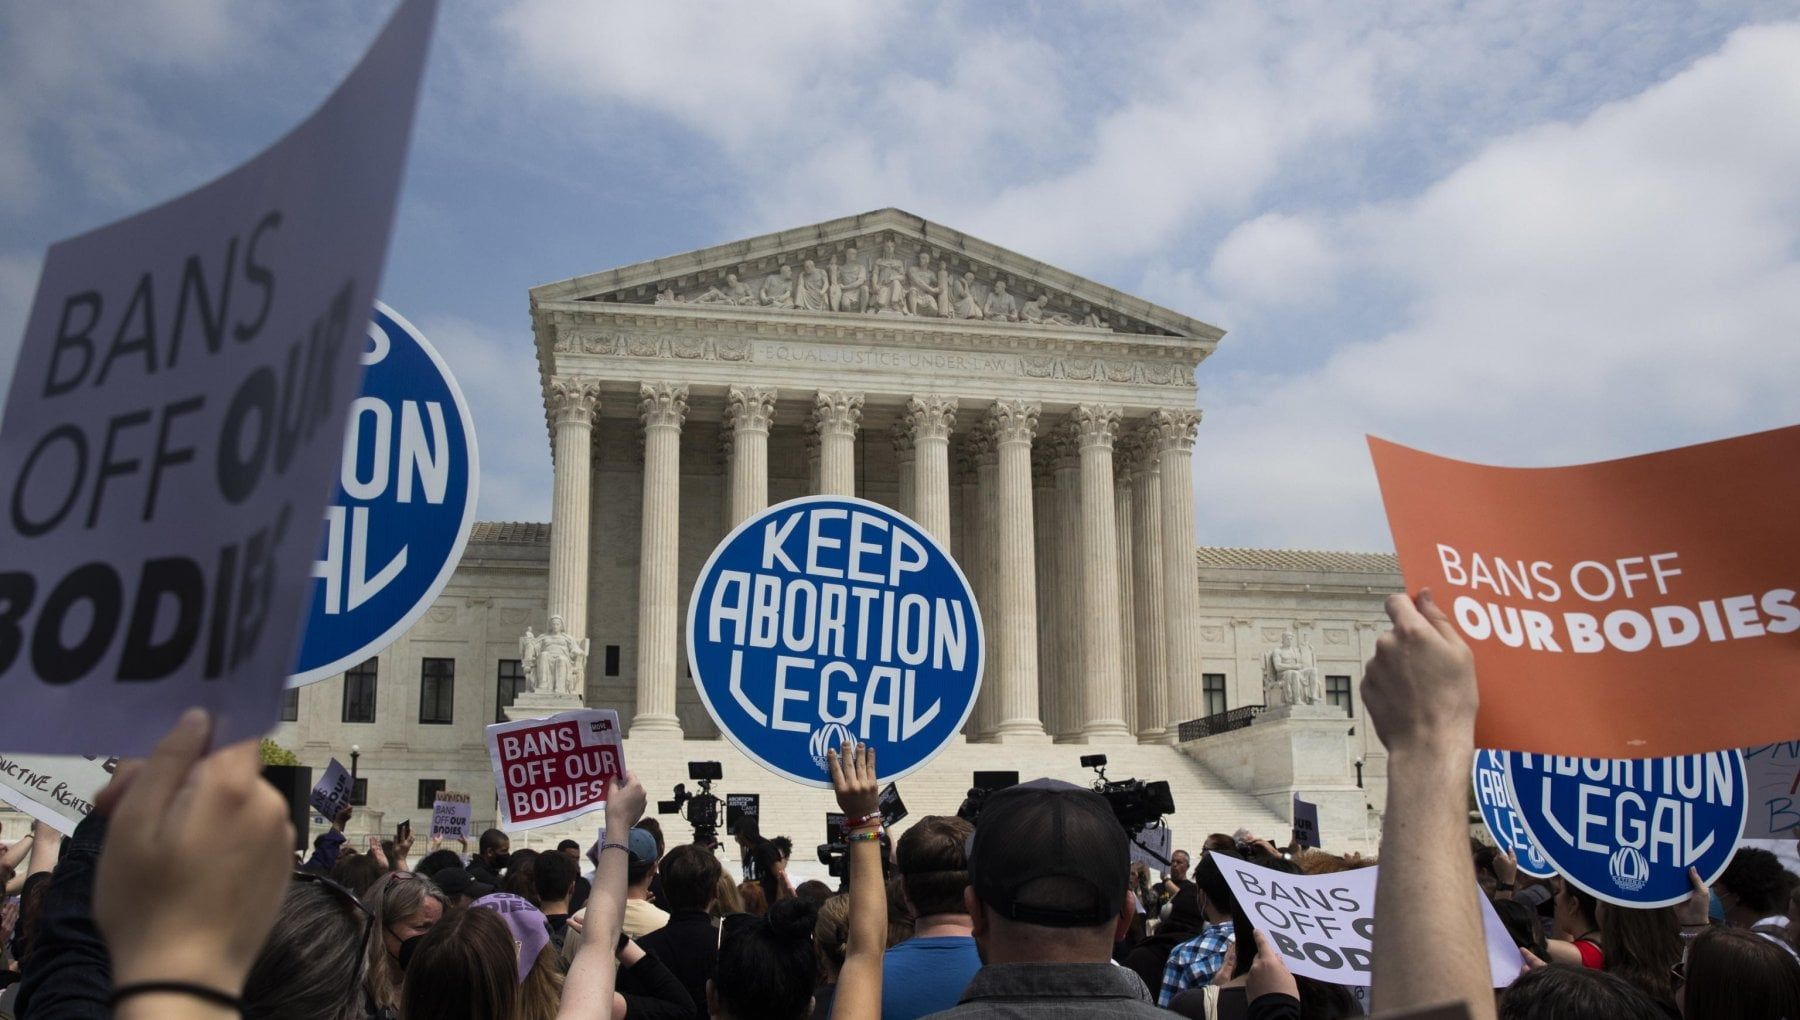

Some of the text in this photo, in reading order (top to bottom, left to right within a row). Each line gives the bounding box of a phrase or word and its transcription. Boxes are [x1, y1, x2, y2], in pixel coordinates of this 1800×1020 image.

[43, 210, 284, 398] BANS
[766, 346, 1007, 371] EQUAL JUSTICE UNDER LAW
[10, 395, 206, 539] OFF
[762, 509, 929, 586] KEEP
[1436, 543, 1682, 602] BANS OFF
[708, 569, 967, 672] ABORTION
[1453, 588, 1800, 653] OUR BODIES
[729, 650, 941, 743] LEGAL
[503, 727, 576, 760] BANS
[508, 750, 618, 788] OFF OUR
[436, 804, 456, 816] BANS
[513, 780, 604, 817] BODIES
[433, 825, 462, 835] BODIES
[434, 815, 467, 826] OFF OUR
[1541, 776, 1715, 868] LEGAL
[1609, 847, 1649, 881] NOW
[1235, 869, 1360, 912] BANS
[1255, 901, 1342, 940] OFF
[1269, 929, 1373, 972] BOD
